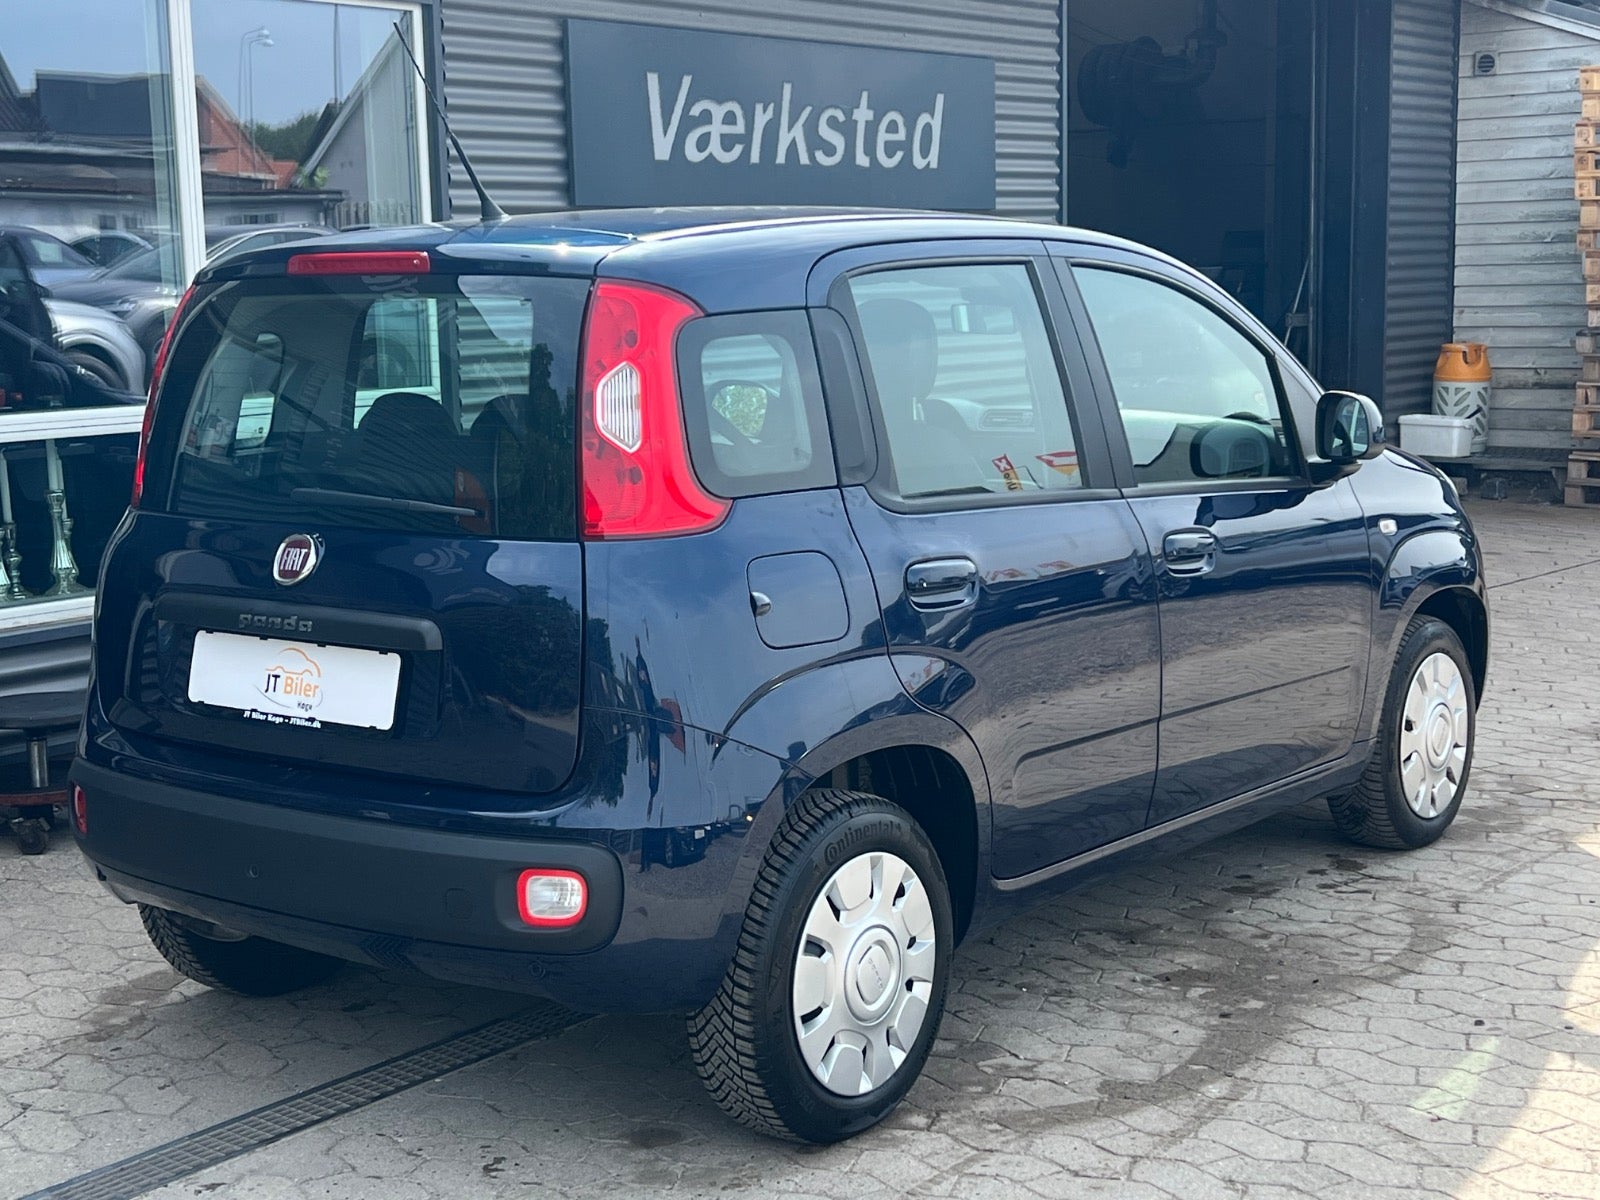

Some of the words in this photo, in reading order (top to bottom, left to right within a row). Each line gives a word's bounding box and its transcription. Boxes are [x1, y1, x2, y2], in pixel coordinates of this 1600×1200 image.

[646, 71, 945, 170] Værksted
[280, 547, 308, 571] FIAT
[239, 614, 313, 632] panda
[264, 673, 281, 693] JT
[283, 674, 319, 698] Biler
[823, 820, 894, 866] Continental
